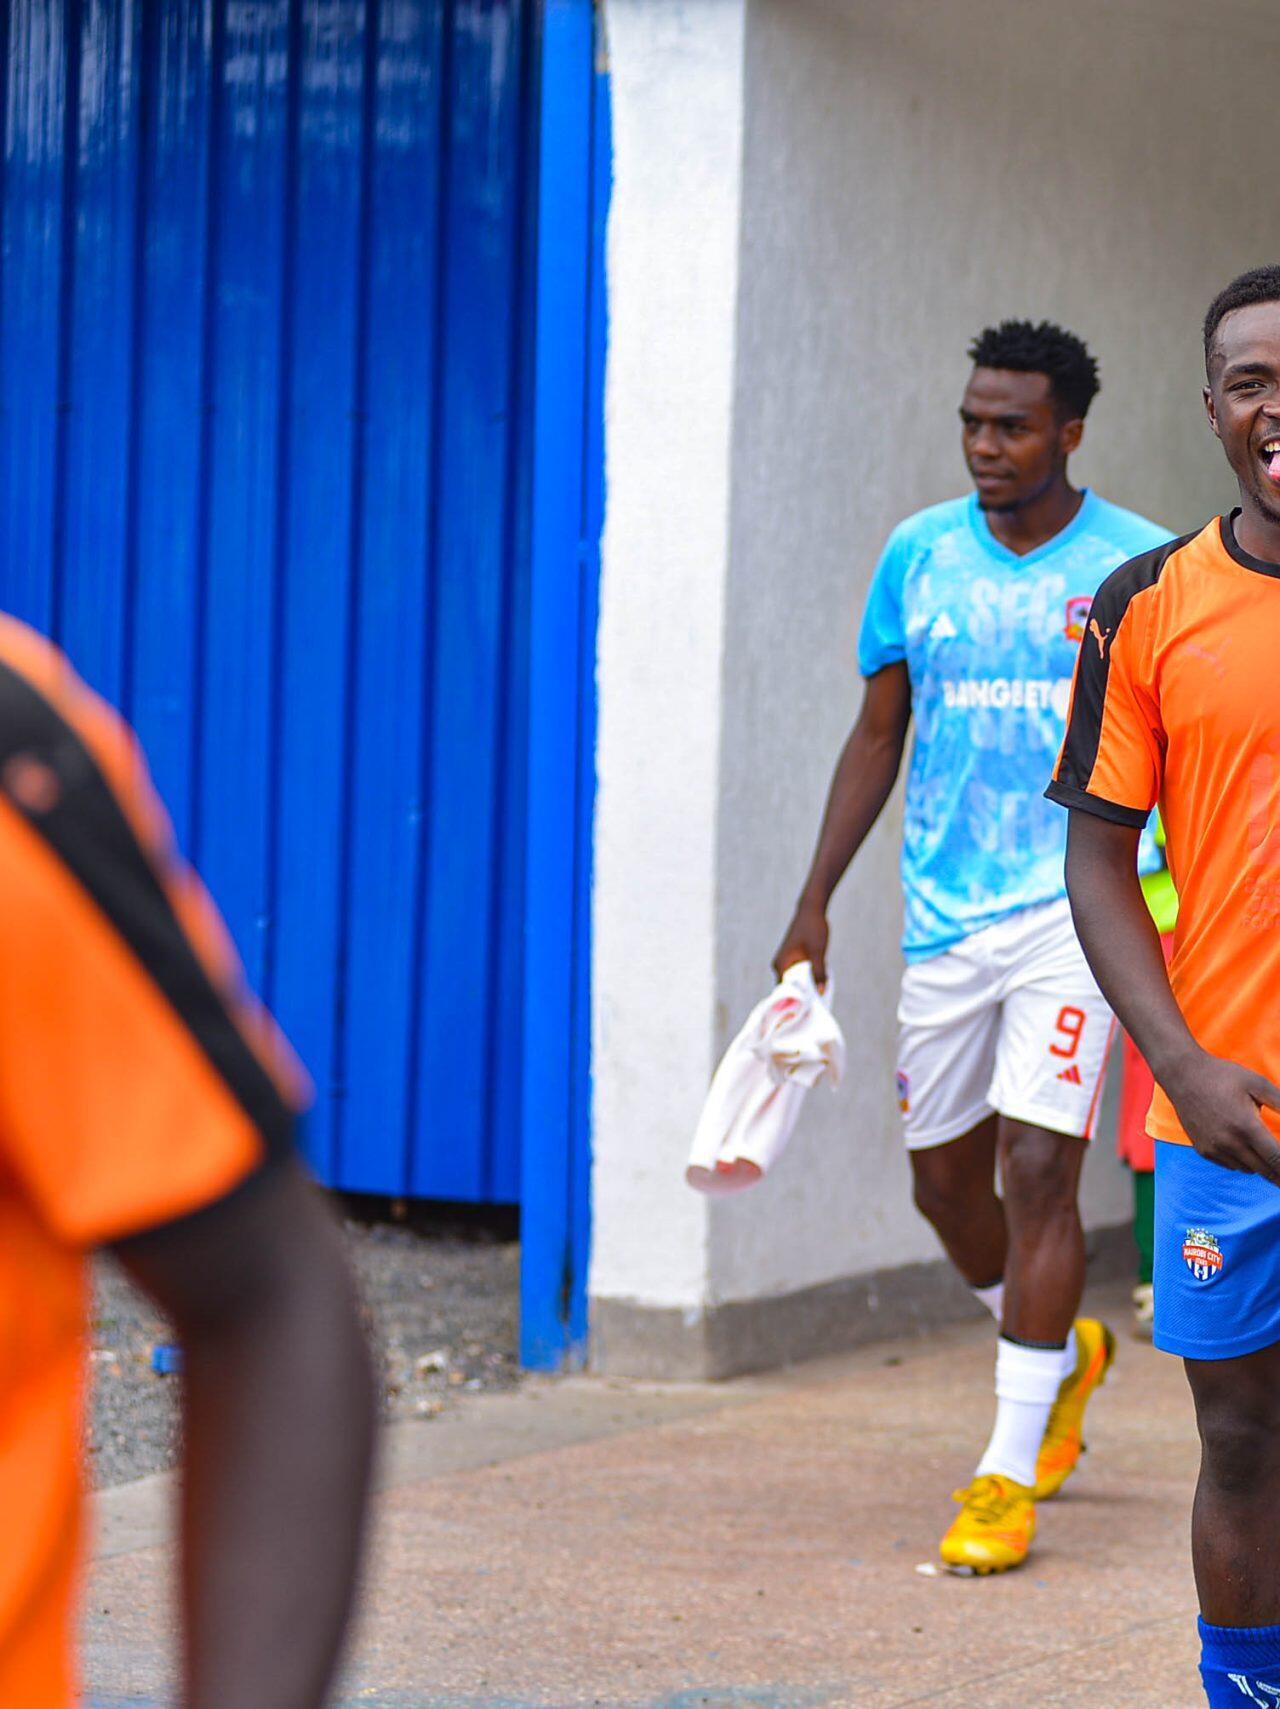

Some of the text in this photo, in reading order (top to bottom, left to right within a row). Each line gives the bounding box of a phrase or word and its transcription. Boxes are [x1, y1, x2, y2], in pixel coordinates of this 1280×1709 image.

[1049, 1004, 1086, 1058] 9
[1184, 1248, 1221, 1264] NAIROBI CITY
